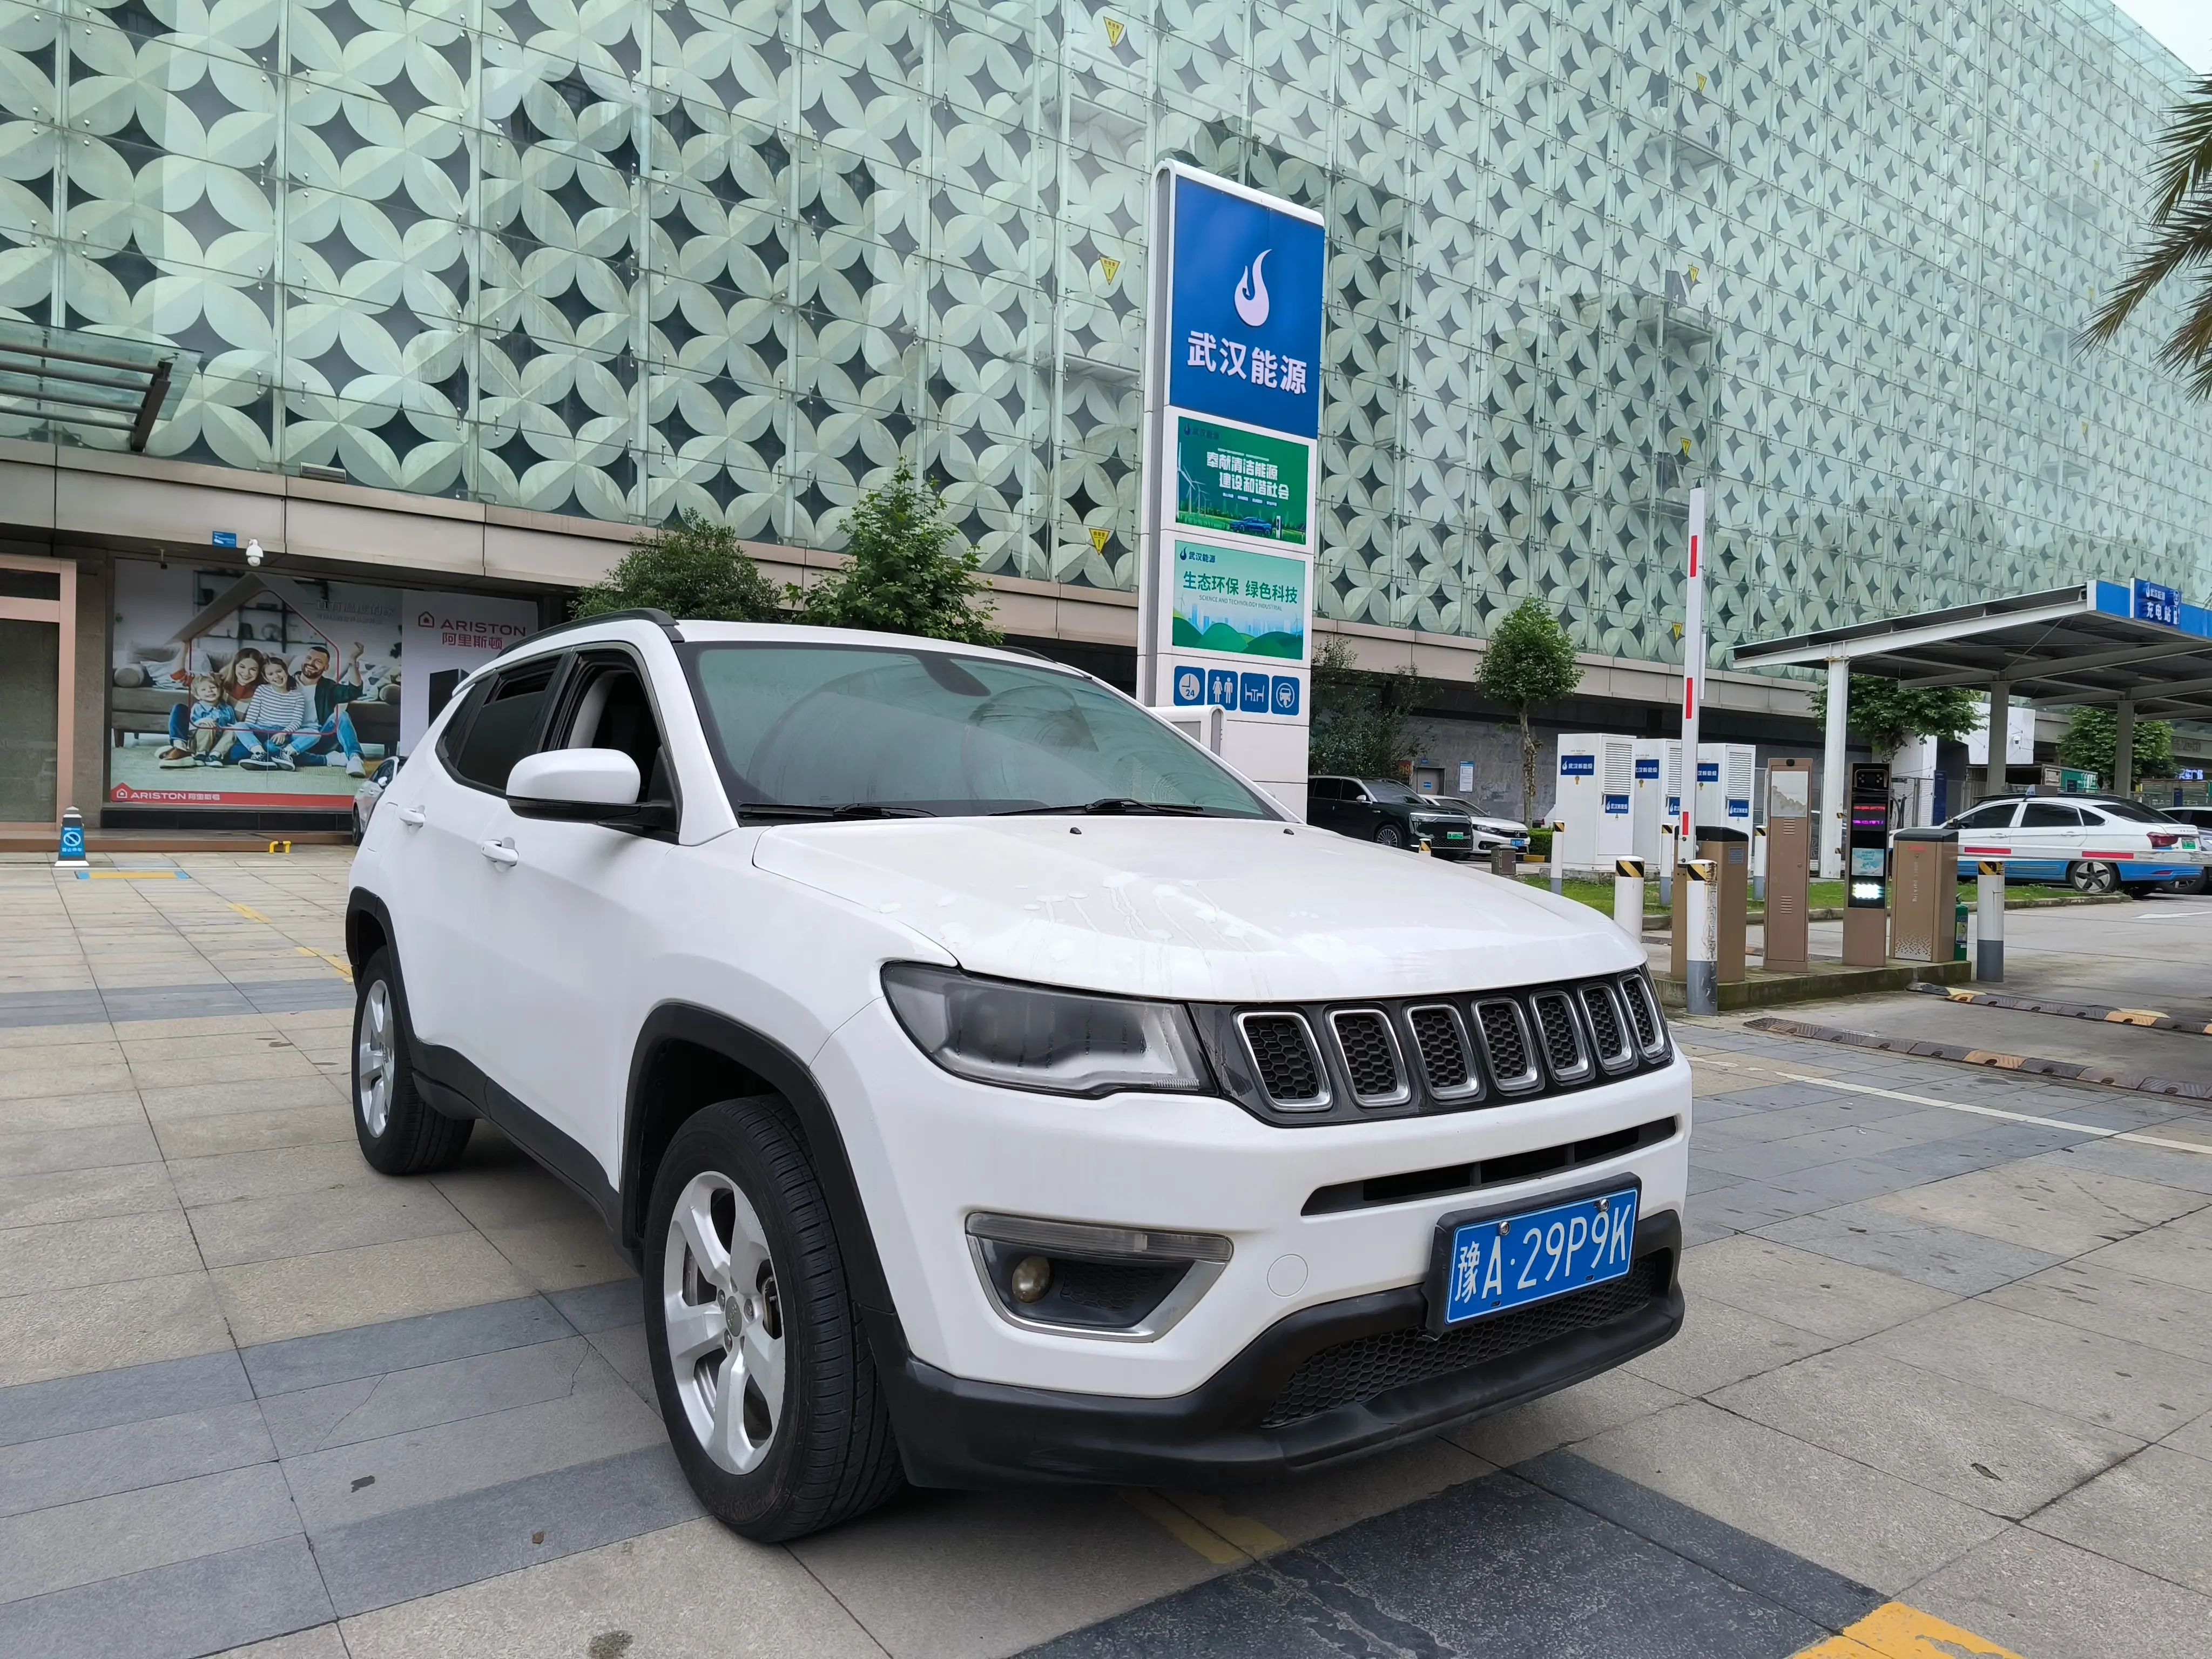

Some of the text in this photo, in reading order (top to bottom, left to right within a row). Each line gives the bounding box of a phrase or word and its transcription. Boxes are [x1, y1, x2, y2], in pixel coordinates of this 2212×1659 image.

[1188, 331, 1307, 394] 武汉能源
[1207, 451, 1278, 480] 奉献清洁能源
[1219, 472, 1289, 500] 建设和谐社会
[1189, 551, 1216, 563] 武汉能源
[1183, 571, 1298, 604] 生态环保 绿色科技
[1229, 599, 1258, 608] TECHNOLOGY
[1258, 602, 1283, 611] INDUSTRIAL
[2147, 602, 2171, 623] 充电站
[440, 619, 526, 637] ARISTON
[442, 632, 503, 650] 阿里斯顿
[1185, 689, 1195, 698] 24
[1454, 1204, 1631, 1304] 豫A·29P9K
